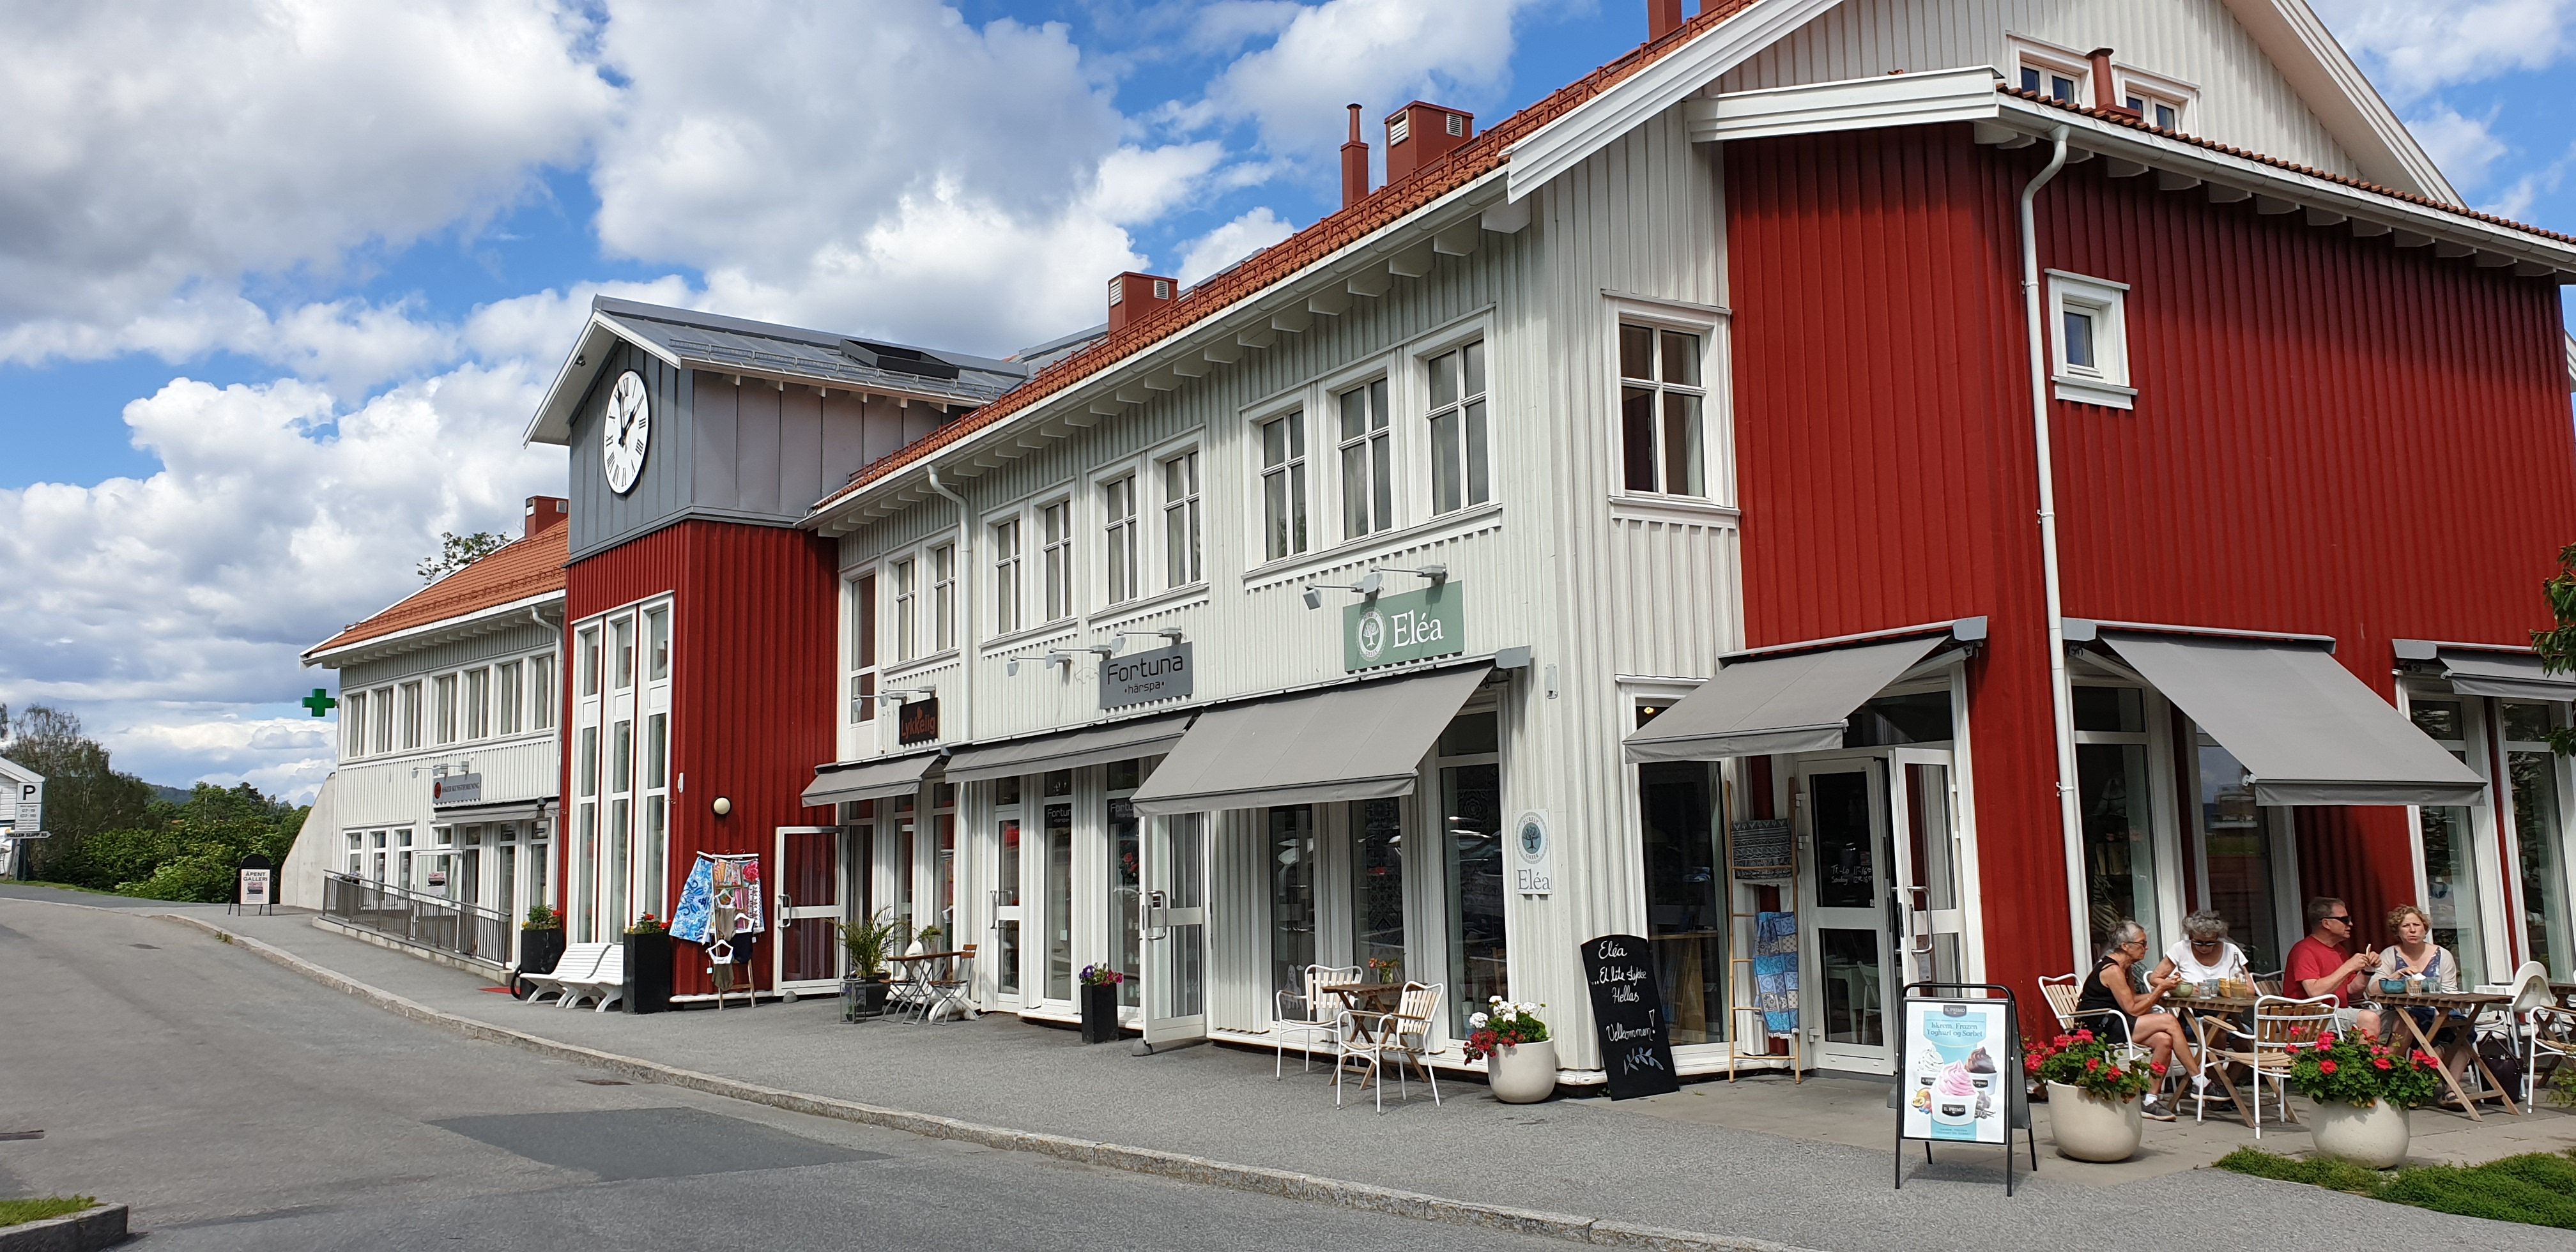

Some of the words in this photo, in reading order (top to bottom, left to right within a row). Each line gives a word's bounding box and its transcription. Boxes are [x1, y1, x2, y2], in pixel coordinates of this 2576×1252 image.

[1391, 609, 1444, 648] Eléa
[1108, 655, 1183, 685] Fortuna
[901, 714, 935, 739] Lykkelig
[23, 785, 36, 800] P
[1517, 869, 1551, 890] Eléa
[1598, 940, 1628, 959] Eléa
[1611, 965, 1625, 982] lite
[1611, 984, 1639, 1004] Hellas
[1606, 1009, 1656, 1042] Velkommen!
[1927, 1028, 1951, 1037] Yoghurt
